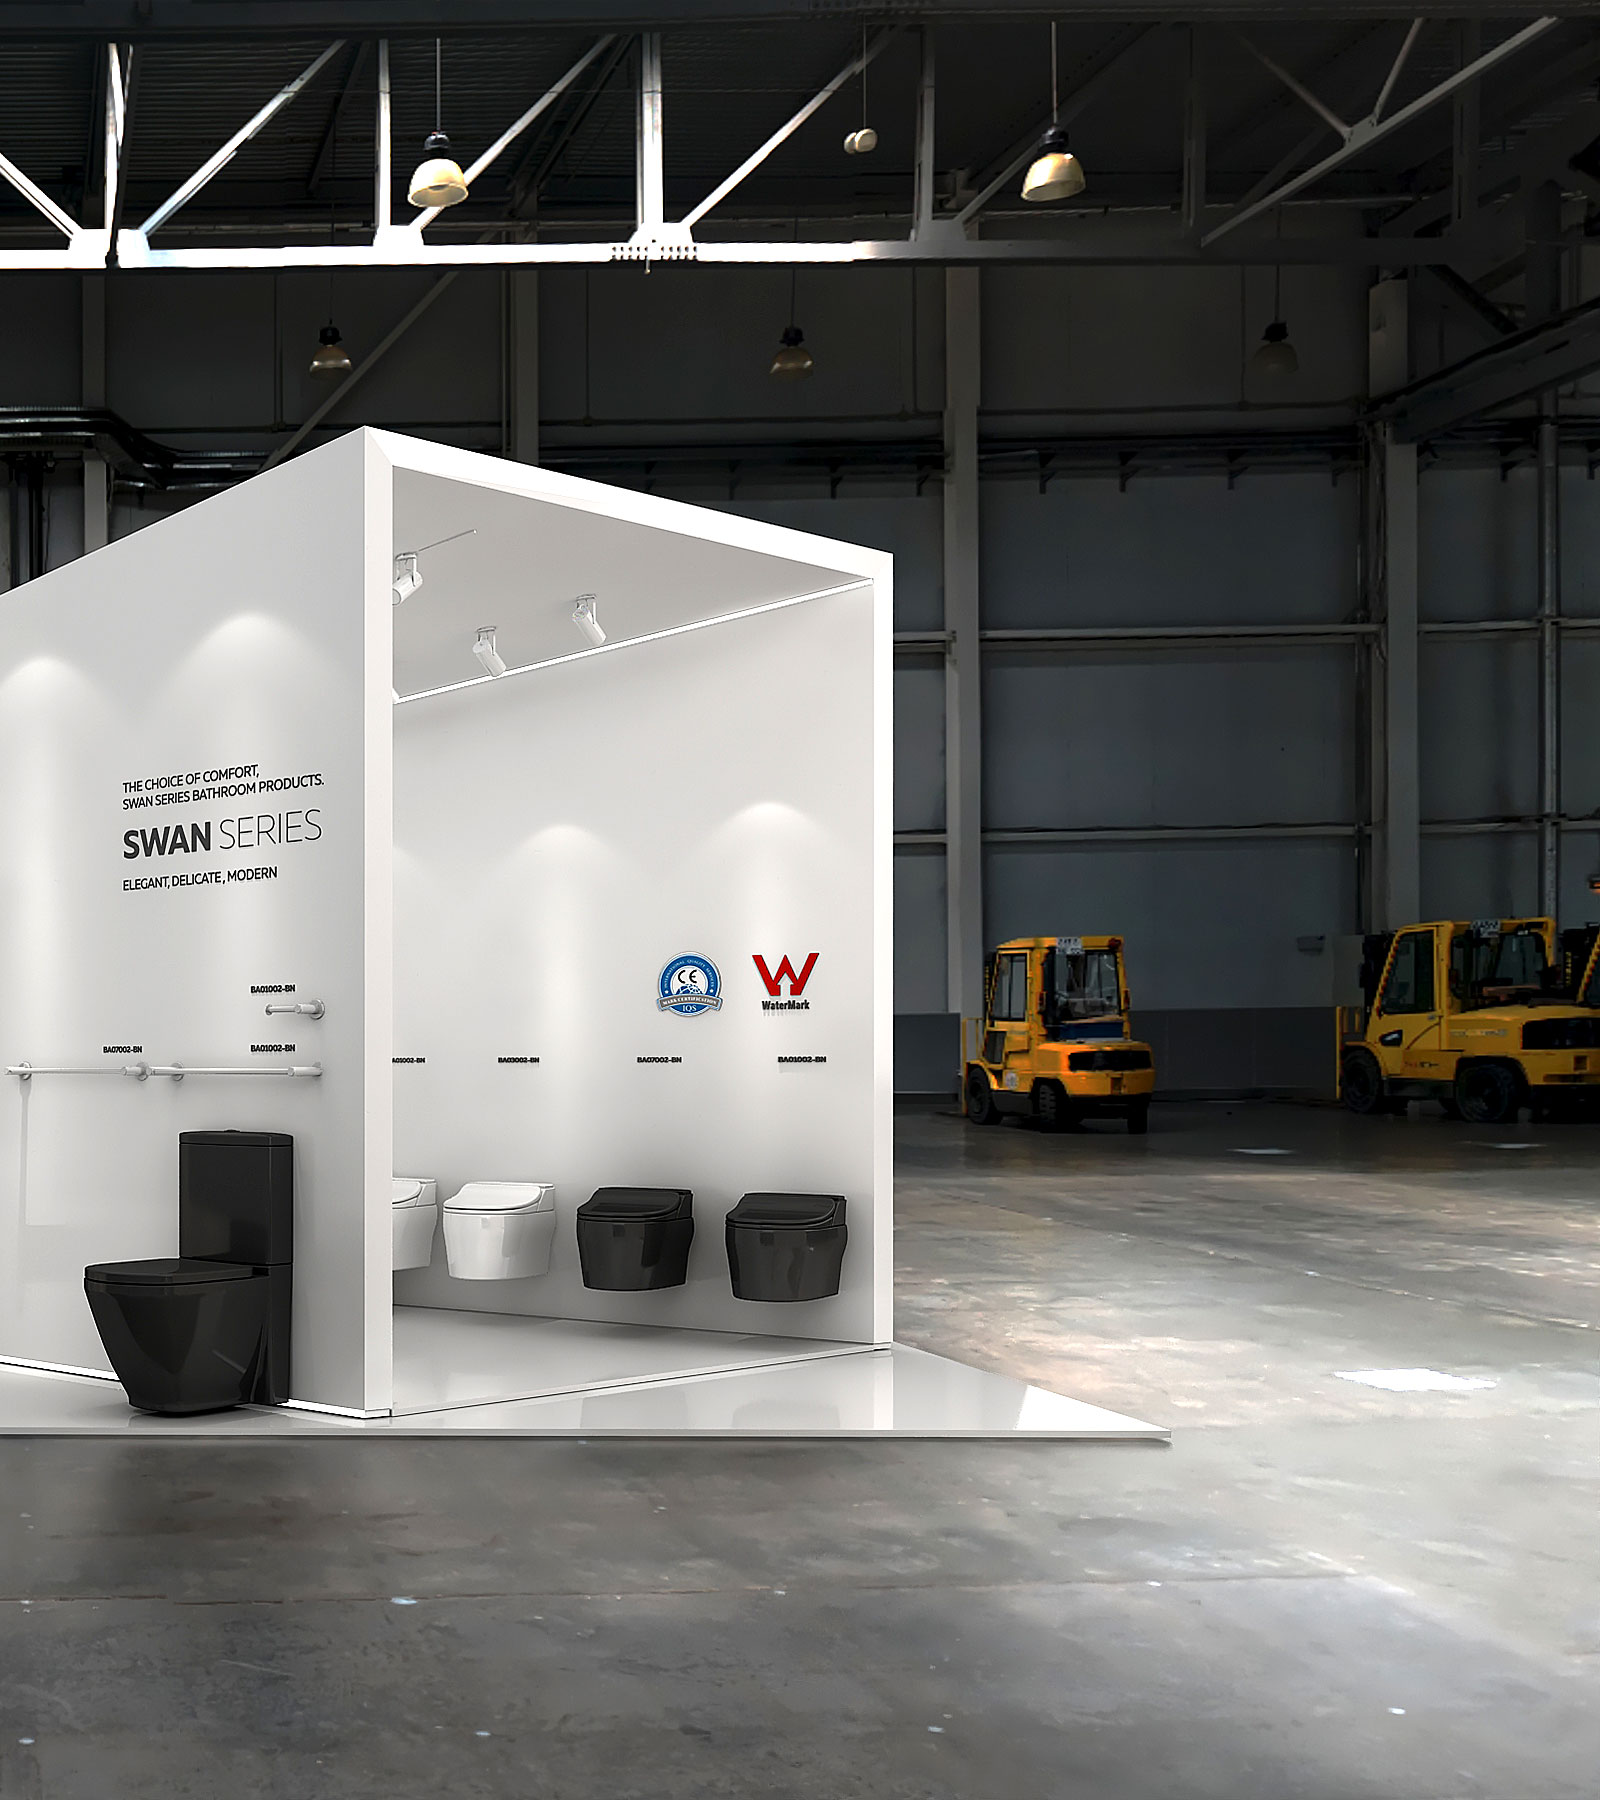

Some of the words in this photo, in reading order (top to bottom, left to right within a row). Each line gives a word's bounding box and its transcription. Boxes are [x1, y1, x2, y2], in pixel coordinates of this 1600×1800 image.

[122, 780, 143, 794] THE
[144, 775, 184, 791] CHOICE
[185, 772, 201, 785] OF
[202, 764, 260, 783] COMFORT,
[122, 796, 153, 811] SWAN
[155, 790, 190, 807] SERIES
[192, 782, 256, 801] BATHROOM
[258, 773, 325, 794] PRODUCTS.
[123, 821, 211, 860] SWAN
[219, 808, 322, 850] SERIES
[123, 875, 171, 891] ELEGANT,
[171, 871, 226, 887] DELICATE,
[227, 866, 278, 882] MODERN
[677, 969, 698, 984] CE
[250, 984, 296, 994] BA01002-BN
[682, 1004, 697, 1012] IQS
[761, 999, 811, 1011] WaterMark
[250, 1044, 296, 1053] BA01002-BN
